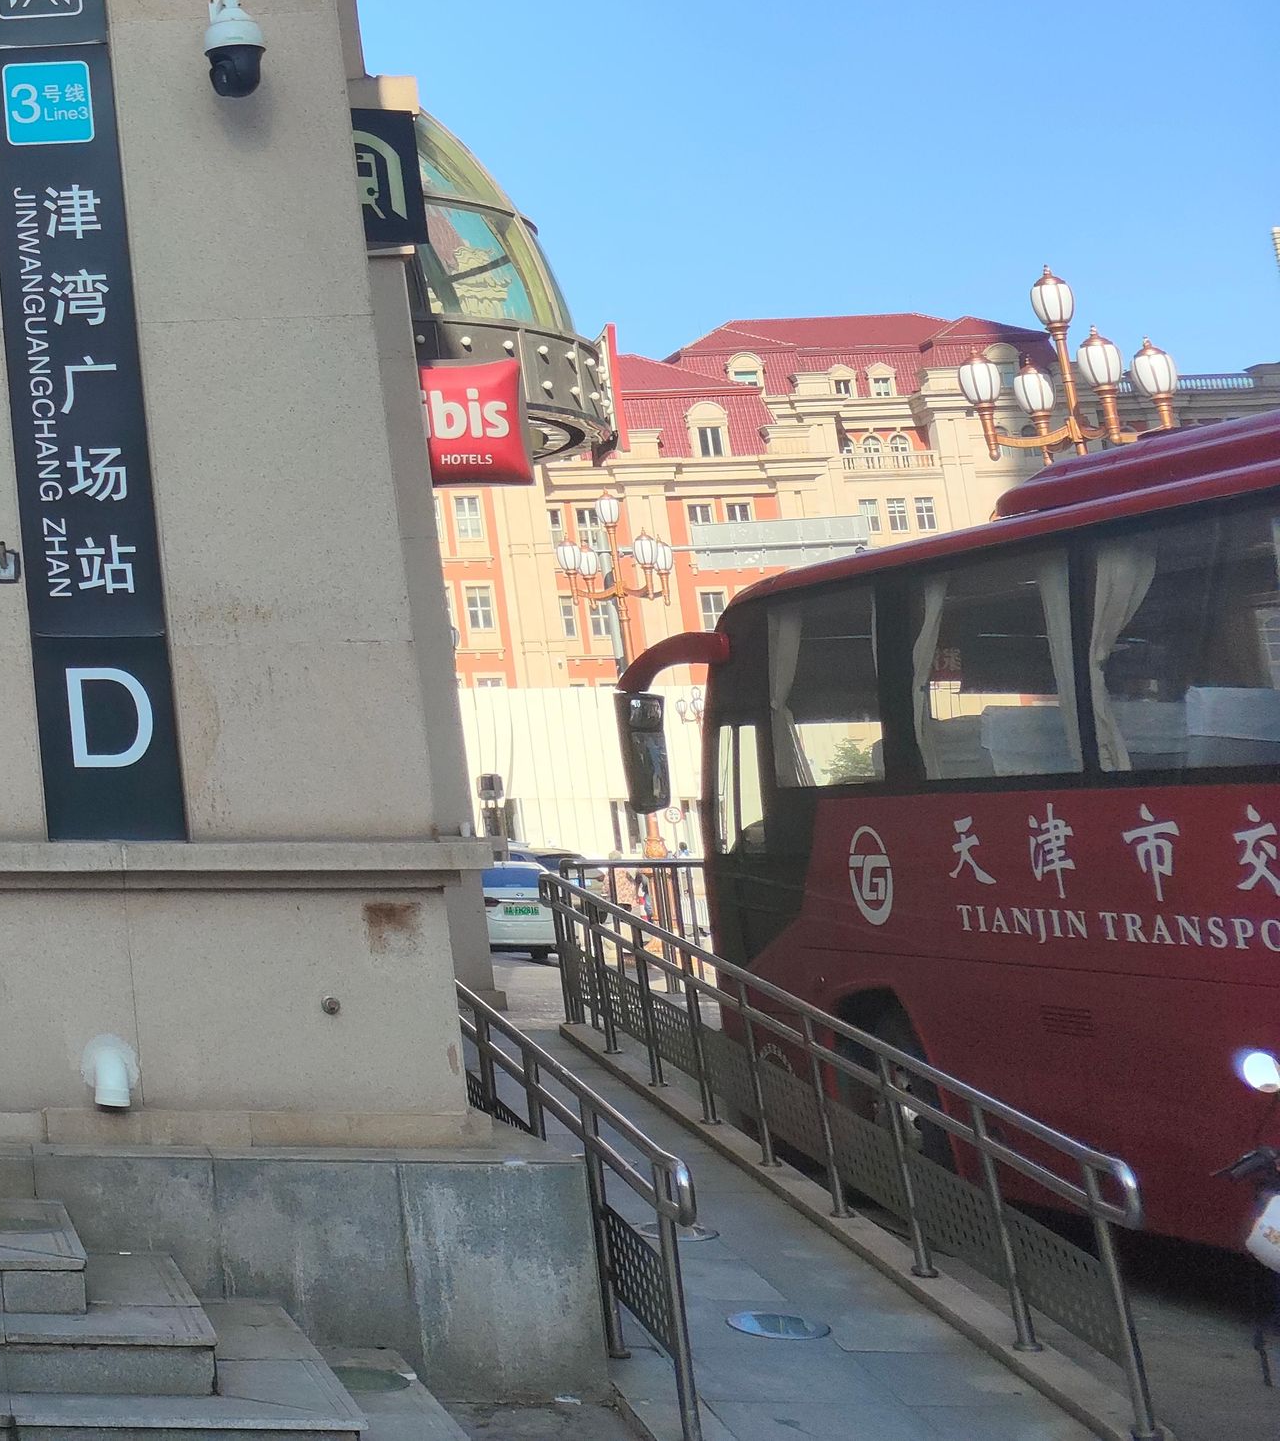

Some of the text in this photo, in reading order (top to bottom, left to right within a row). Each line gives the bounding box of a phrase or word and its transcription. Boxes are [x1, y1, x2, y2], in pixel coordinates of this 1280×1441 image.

[43, 106, 90, 122] Line3
[13, 187, 74, 598] JINWANGUANGCHANG ZHAN
[42, 183, 137, 595] 津湾广场站
[441, 454, 493, 465] HOTELS
[64, 667, 154, 768] D
[949, 803, 1280, 902] 天津市交
[956, 904, 1089, 944] TIANJIN
